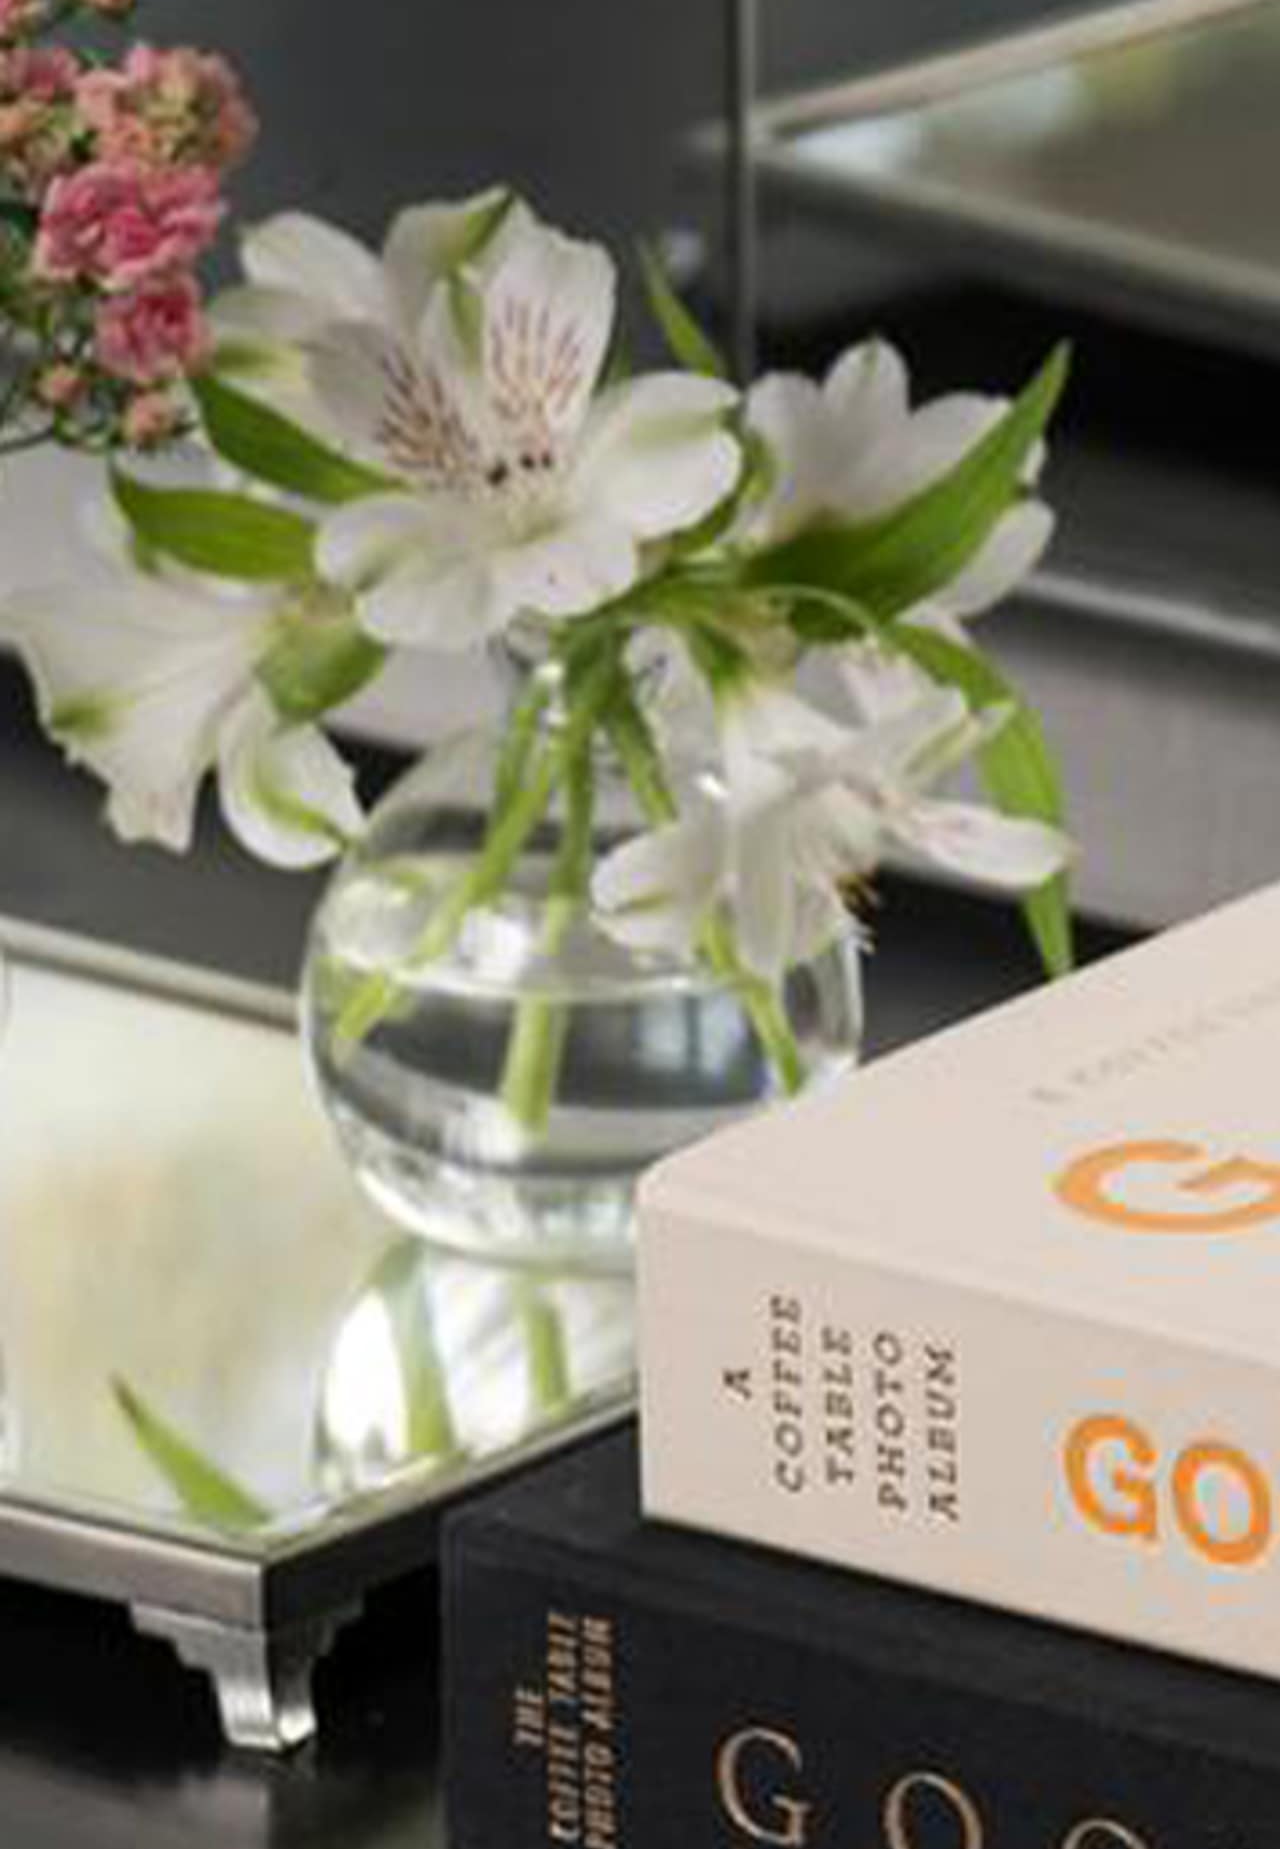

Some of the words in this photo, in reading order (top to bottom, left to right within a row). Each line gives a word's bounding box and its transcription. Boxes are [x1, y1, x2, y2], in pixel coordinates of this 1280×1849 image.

[721, 1367, 754, 1402] A
[768, 1293, 807, 1494] COFFEE
[820, 1325, 856, 1486] TABLE
[870, 1329, 909, 1513] PHOTO
[922, 1343, 960, 1523] ALBUM
